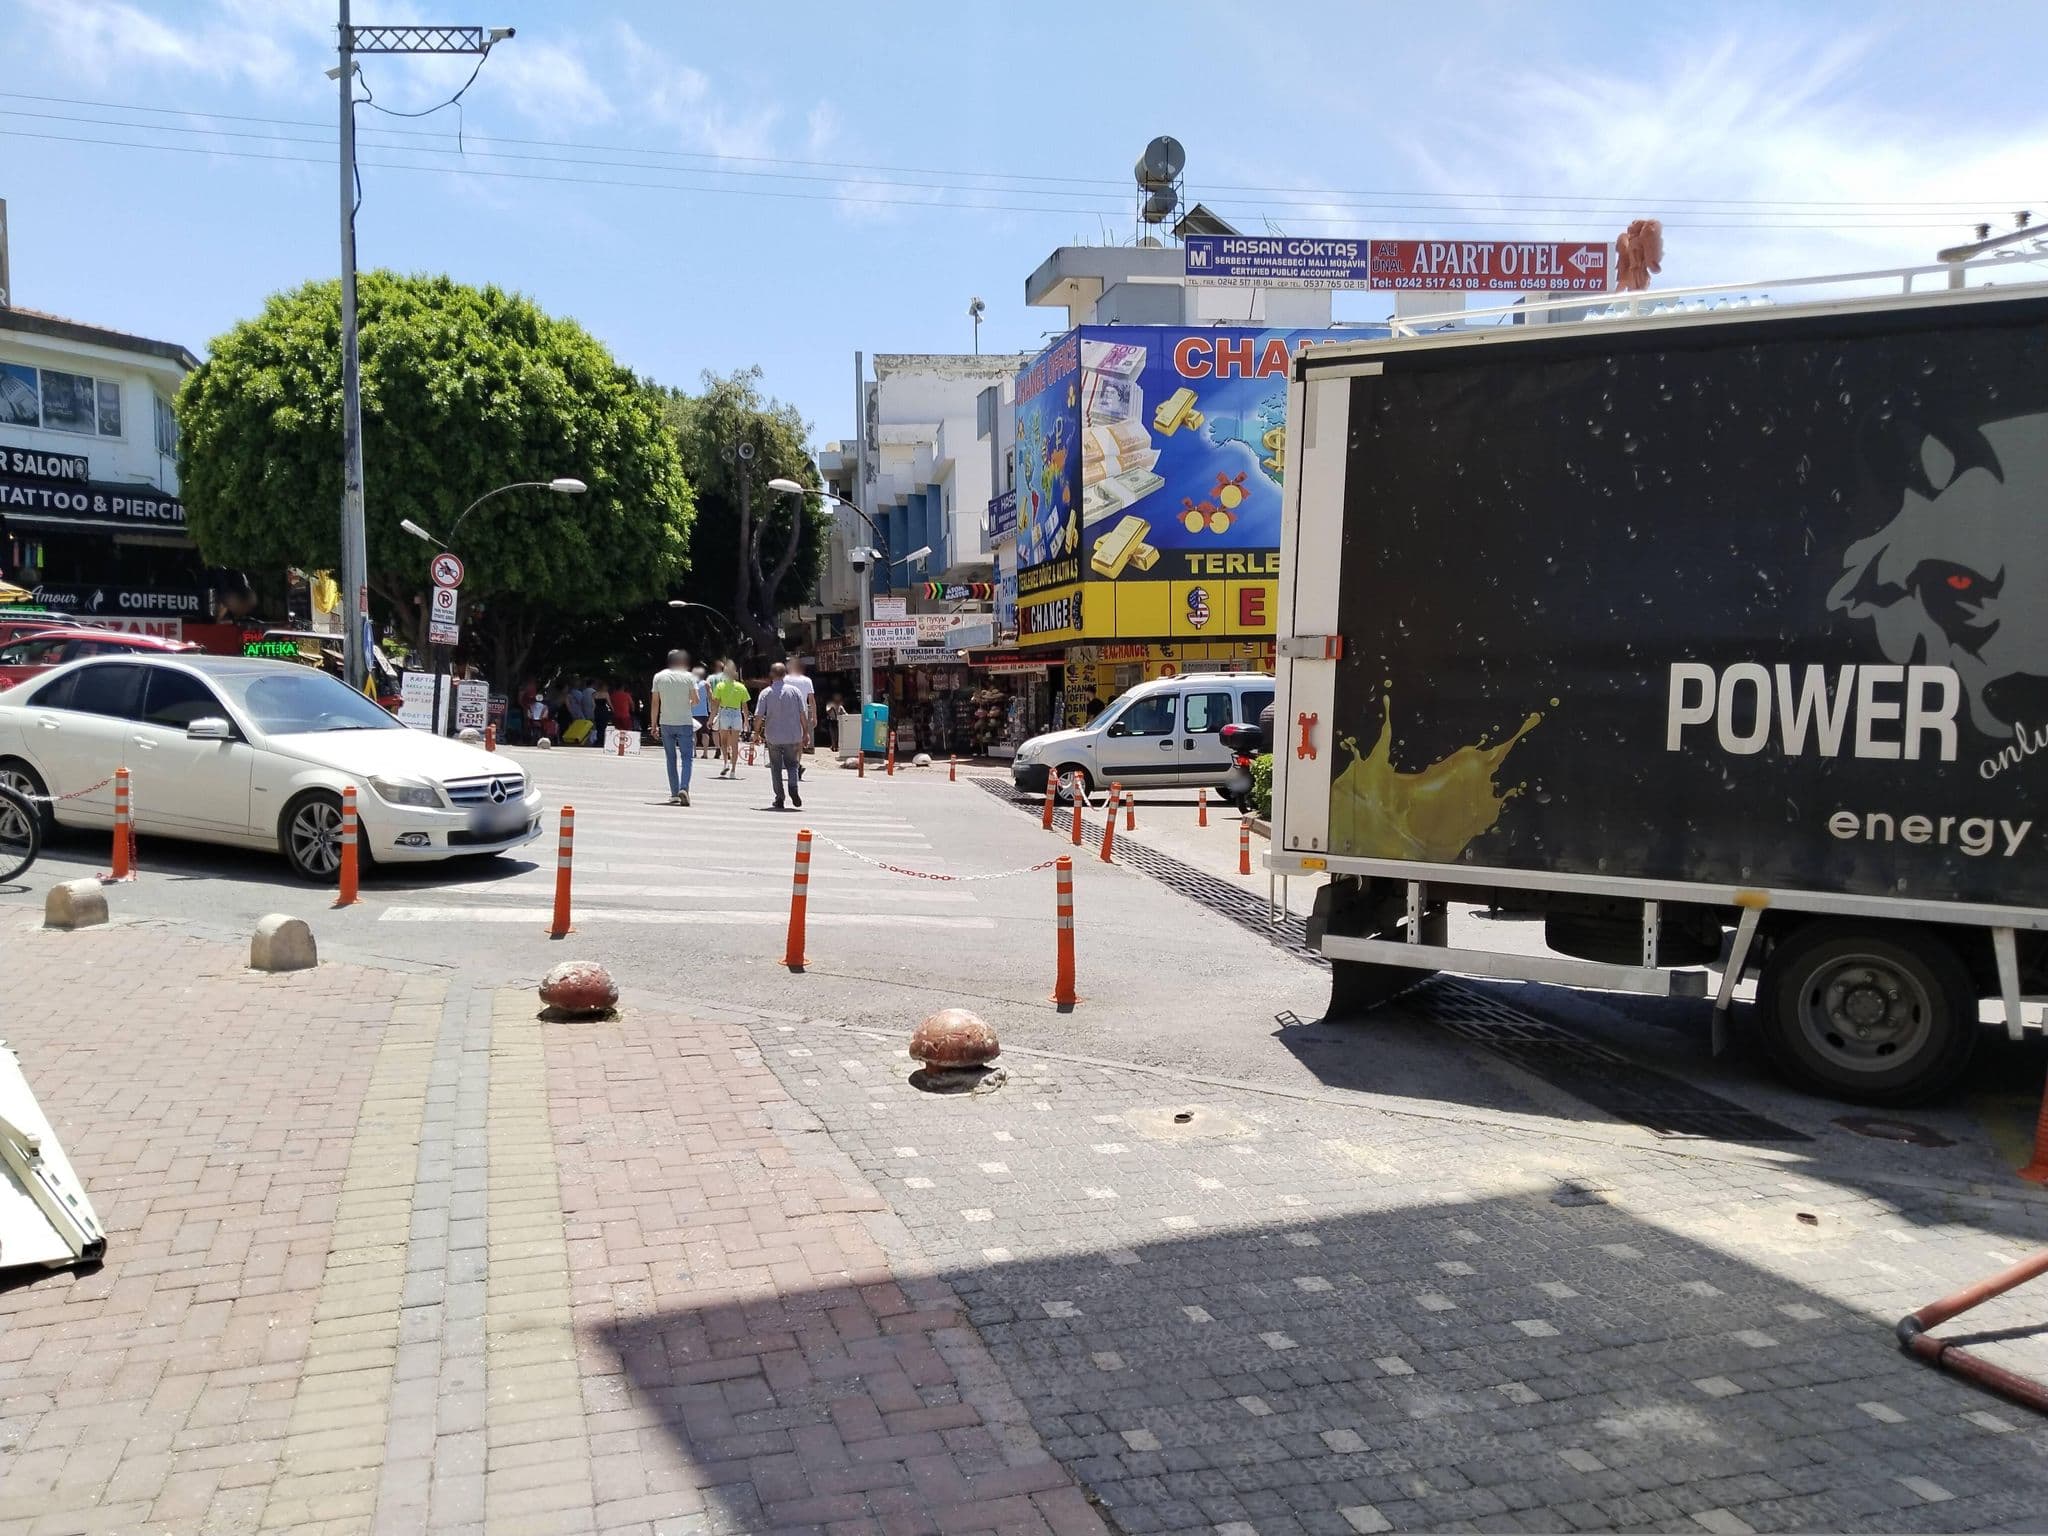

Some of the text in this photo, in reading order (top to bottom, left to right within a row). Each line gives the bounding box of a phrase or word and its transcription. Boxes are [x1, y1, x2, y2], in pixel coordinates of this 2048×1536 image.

[1223, 239, 1358, 260] HASAN GÖKTAŞ
[1412, 243, 1564, 276] APART OTEL
[1574, 252, 1602, 266] 100 mt
[1214, 256, 1366, 269] SERBEST MUHASEBECİ MALİ MÜŞAVİR
[1230, 267, 1351, 278] CERTIFIED PUBLIC ACCOUNTANT
[1371, 257, 1404, 273] ÜNAL
[1217, 278, 1237, 287] 0242
[1239, 279, 1251, 287] 517
[1303, 281, 1325, 289] 0537
[1326, 281, 1342, 289] 765
[1344, 281, 1355, 289] 02
[1356, 281, 1366, 289] 15
[1371, 277, 1603, 290] Tel: 0242 517 43 08 Gsm: 0549 899 07 07
[1174, 336, 1310, 379] CHA
[12, 452, 74, 479] SALON
[0, 485, 88, 511] TATTOO
[93, 495, 108, 513] &
[118, 592, 200, 611] COIFFEUR
[1666, 662, 1961, 762] POWER
[1828, 811, 2033, 857] energy
